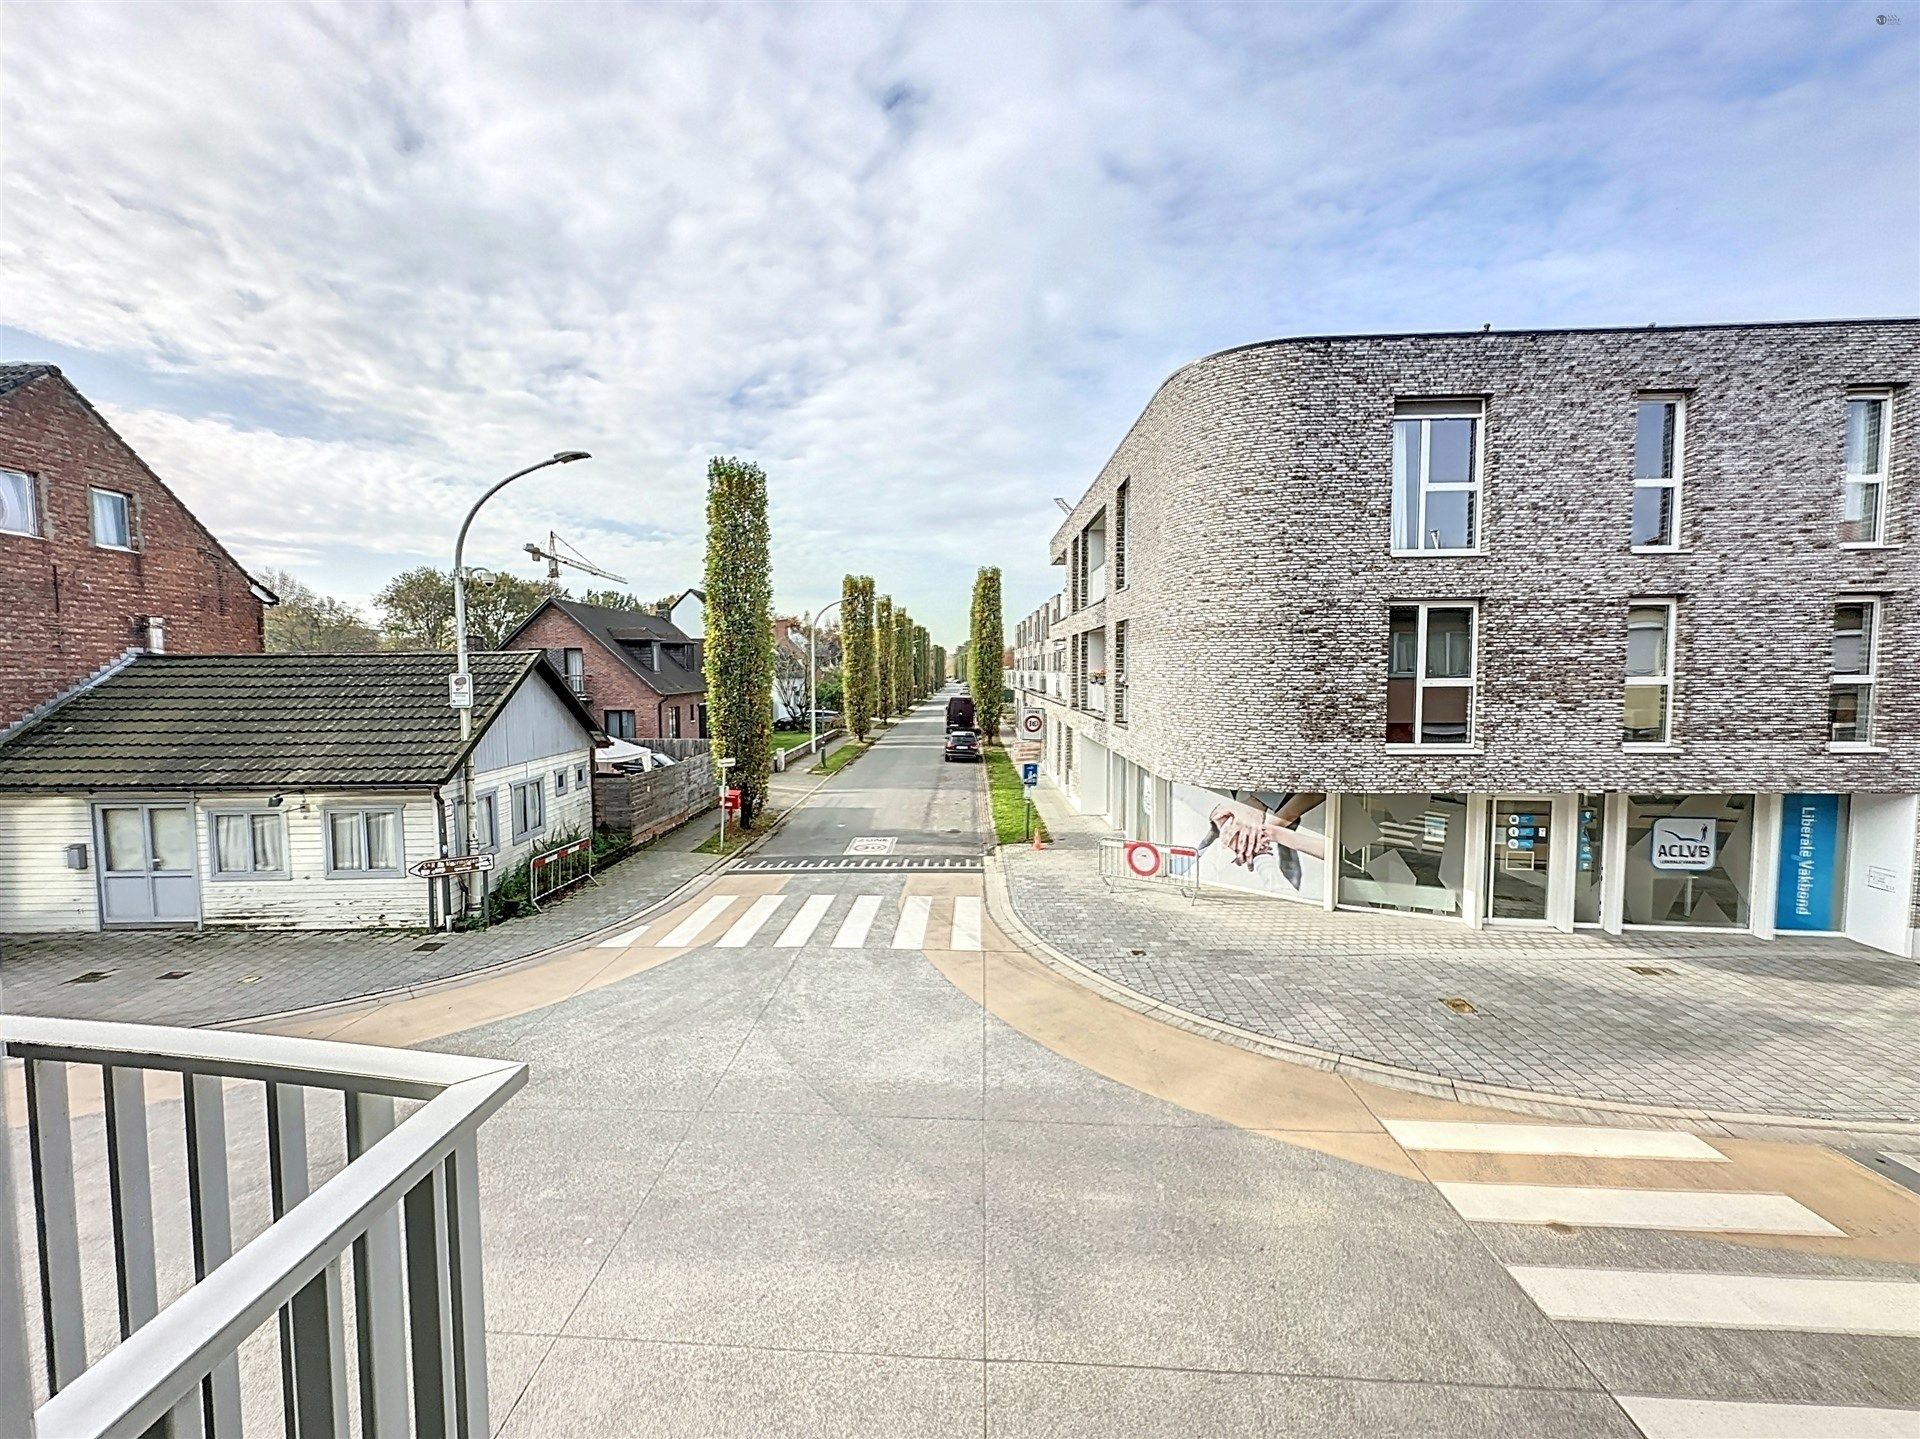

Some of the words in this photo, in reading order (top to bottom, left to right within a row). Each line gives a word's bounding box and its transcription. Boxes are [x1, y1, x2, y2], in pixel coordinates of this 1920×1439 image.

[1658, 845, 1710, 858] ACLVB
[1799, 807, 1817, 858] Liberale
[1796, 860, 1815, 916] Vakbond
